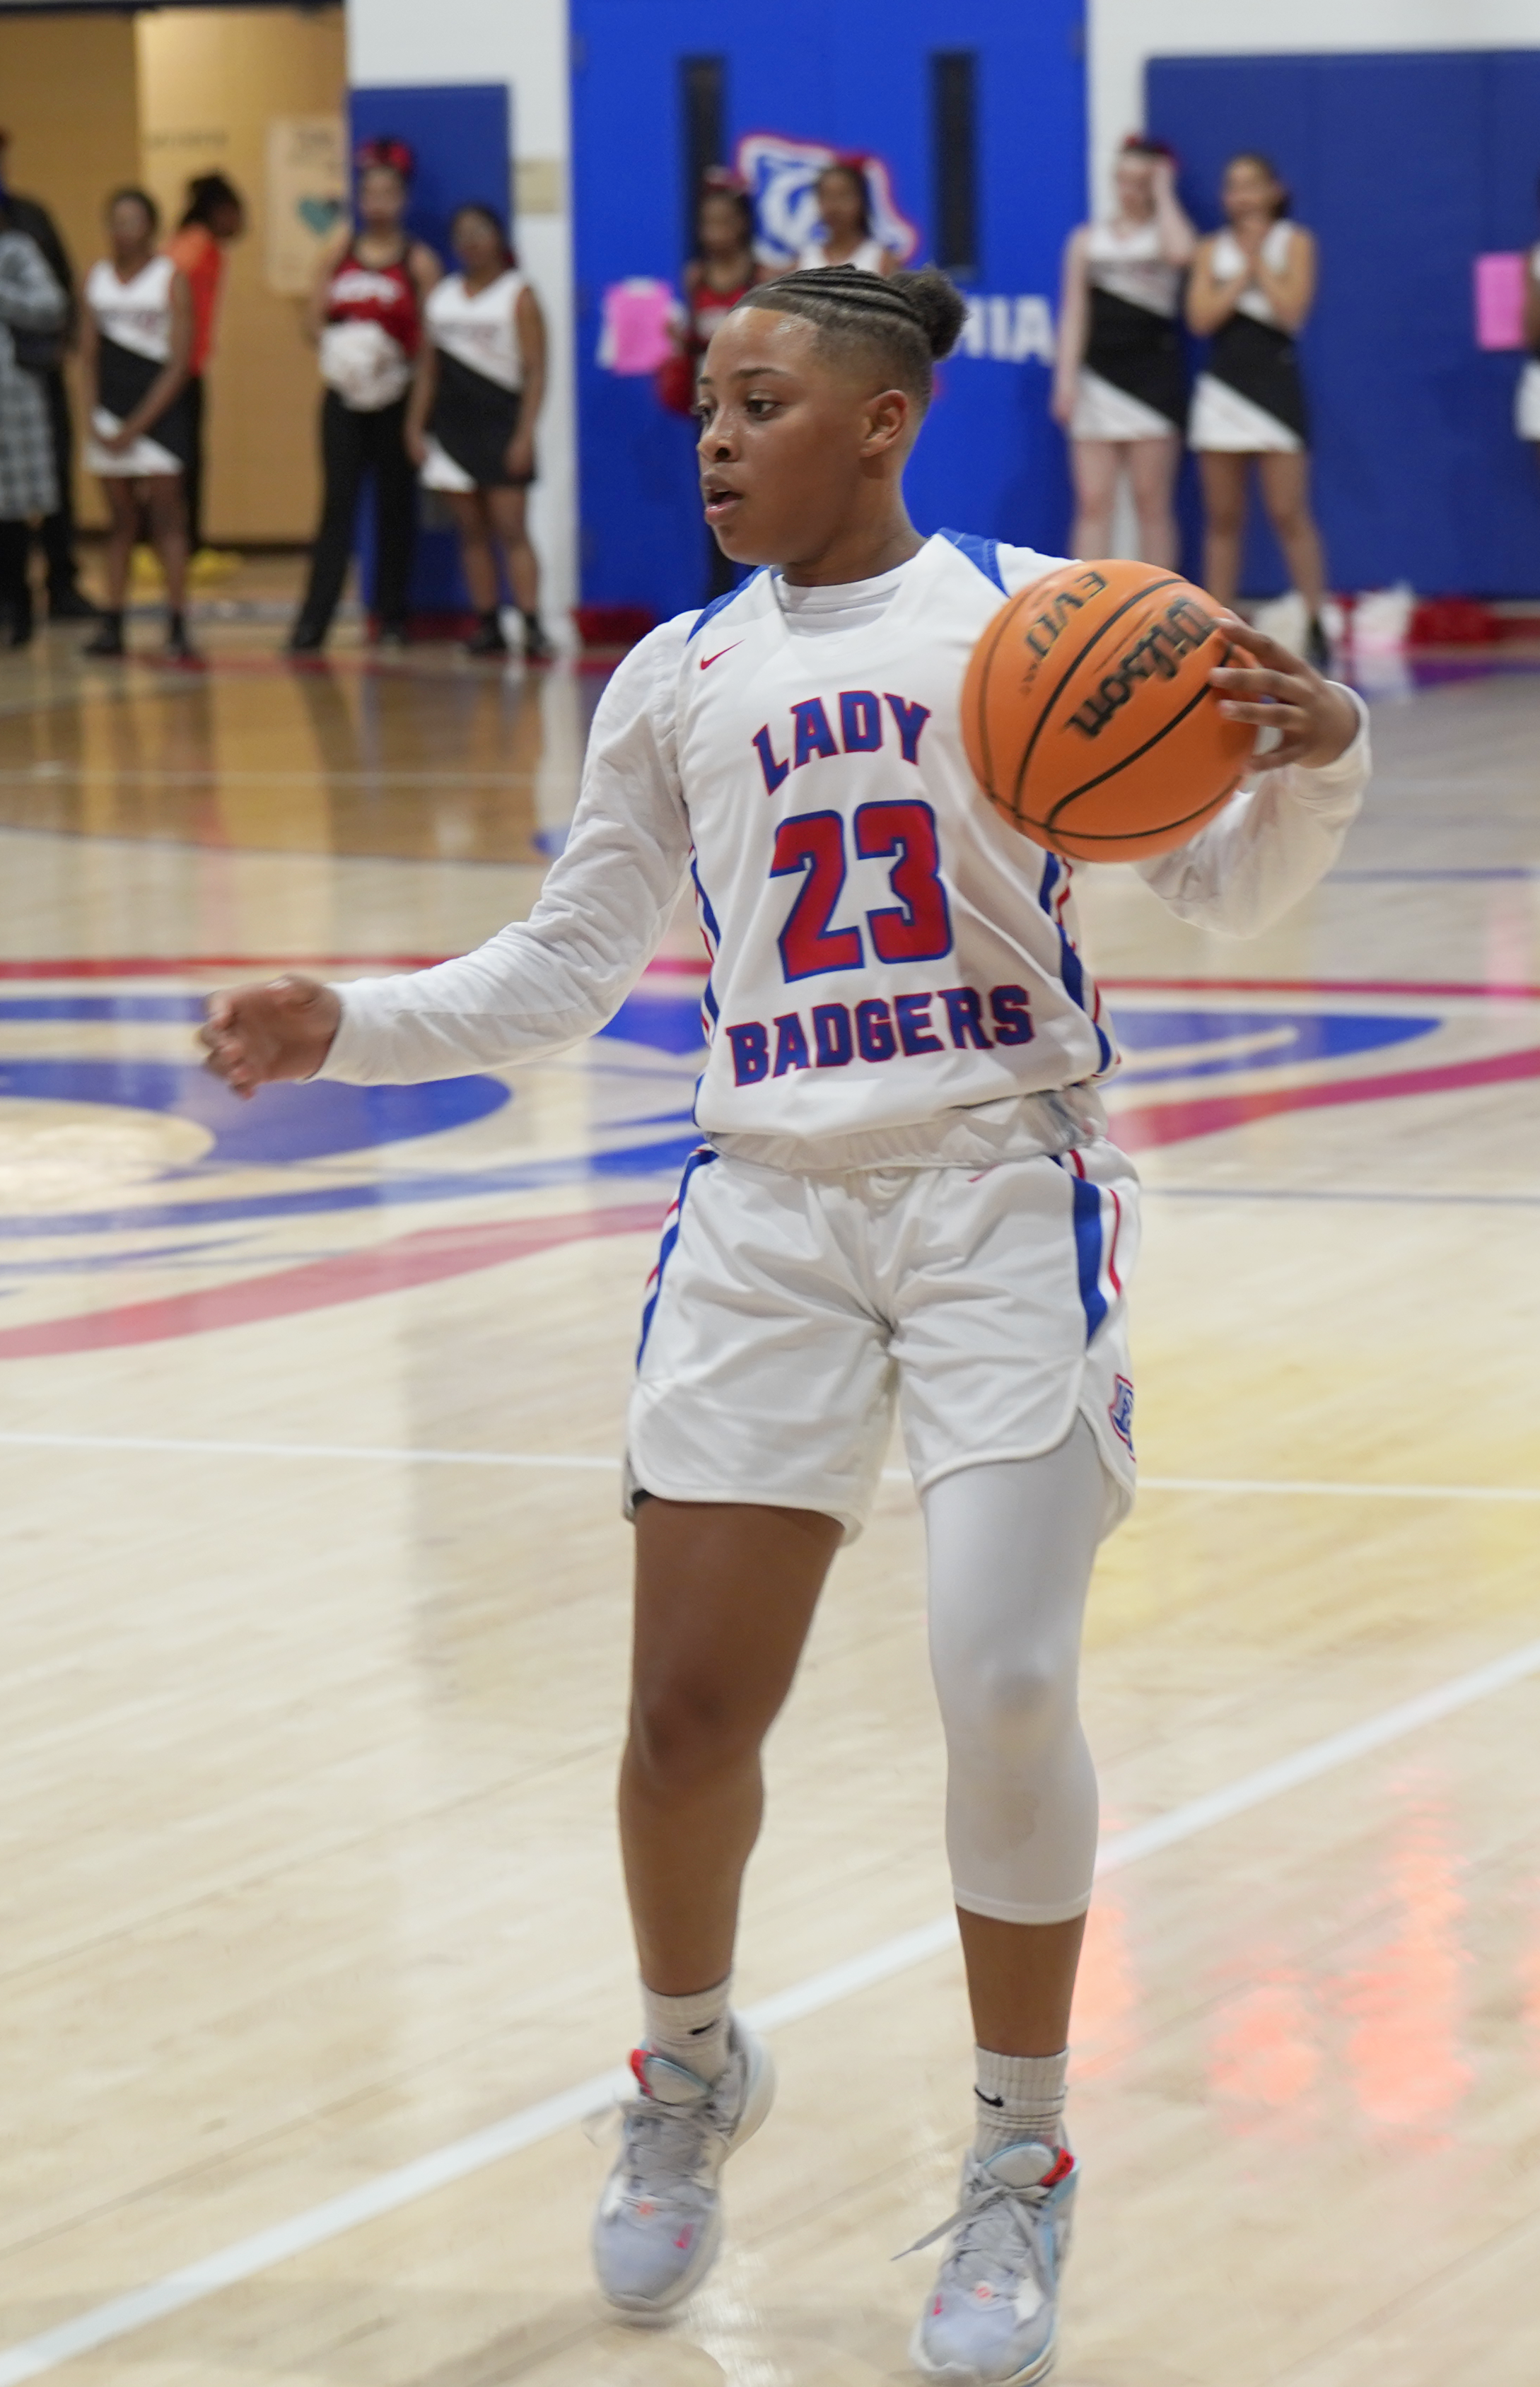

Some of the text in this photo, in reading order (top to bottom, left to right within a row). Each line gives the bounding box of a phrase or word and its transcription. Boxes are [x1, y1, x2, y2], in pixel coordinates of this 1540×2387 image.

[1023, 571, 1107, 659] EVO
[1062, 598, 1219, 738] Wilson
[752, 690, 931, 795] LADY
[769, 799, 954, 984] 23
[725, 984, 1034, 1087] BADGERS
